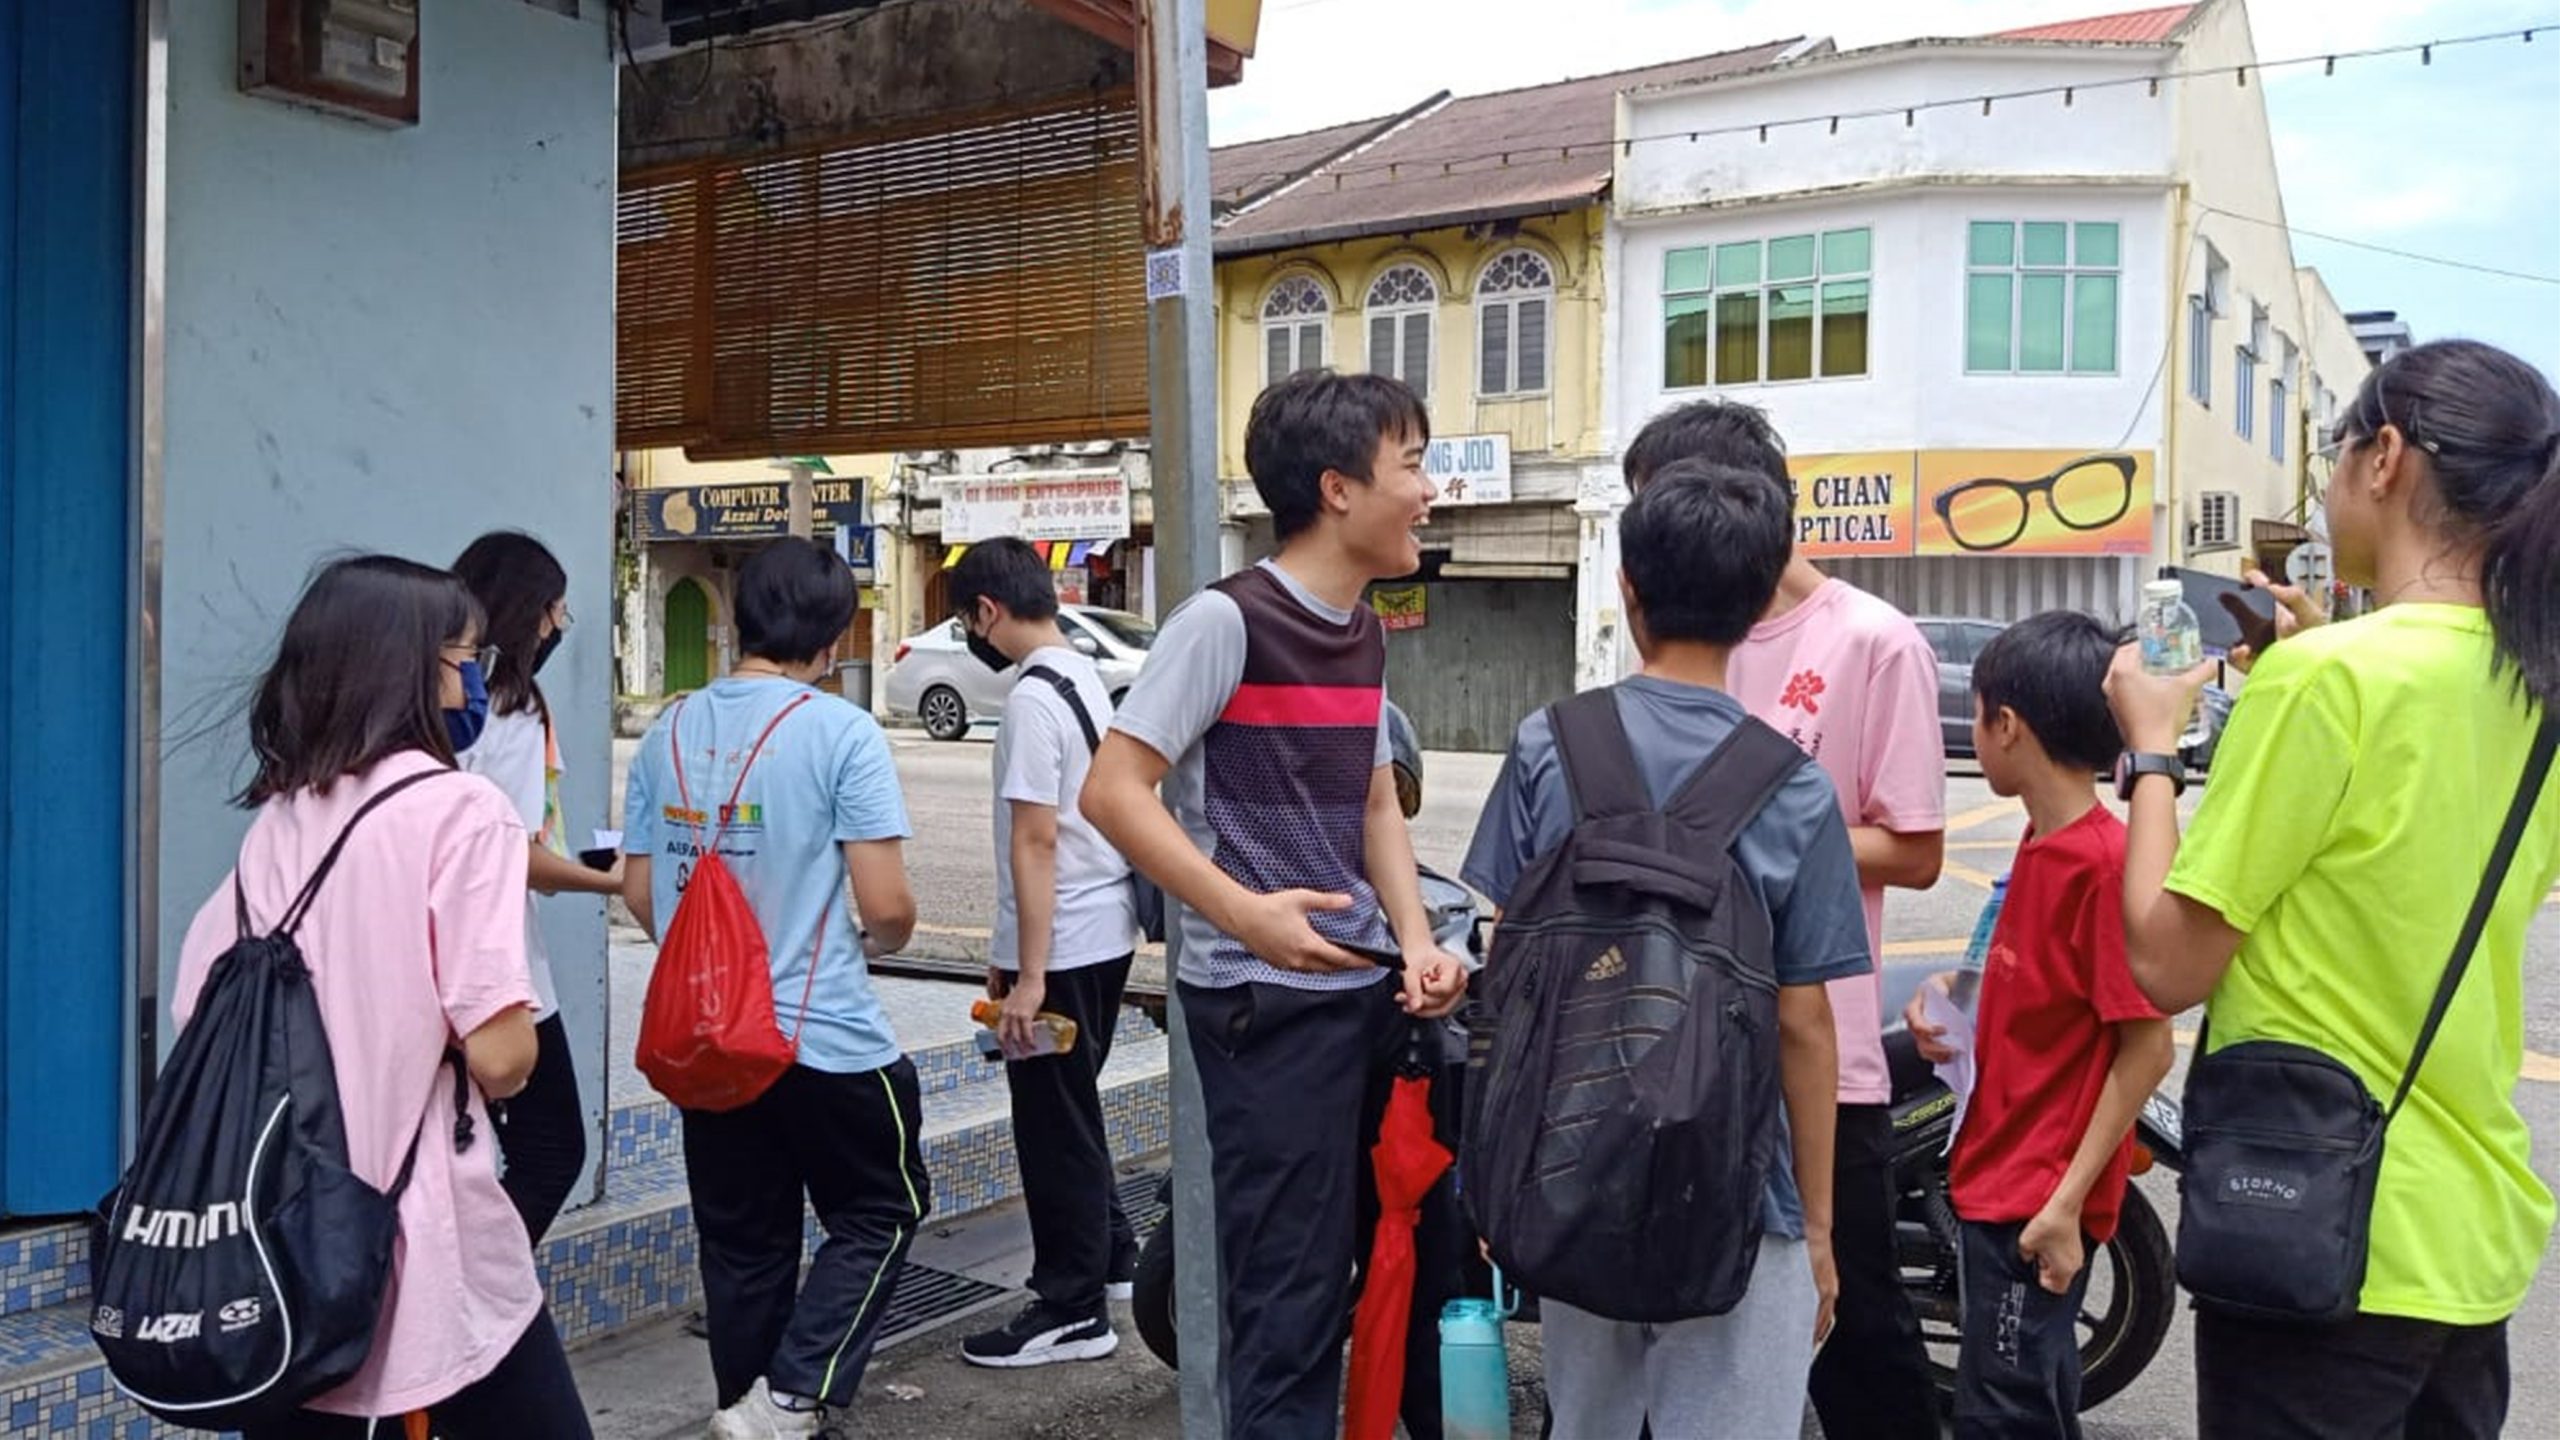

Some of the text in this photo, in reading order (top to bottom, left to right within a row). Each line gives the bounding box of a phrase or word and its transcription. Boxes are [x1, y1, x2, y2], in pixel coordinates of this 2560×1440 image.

[1458, 438, 1494, 473] JOO
[700, 486, 780, 508] COMPUTER
[1024, 478, 1123, 502] ENTERPRISE
[1813, 475, 1892, 508] CHAN
[1799, 513, 1893, 543] PTICAL
